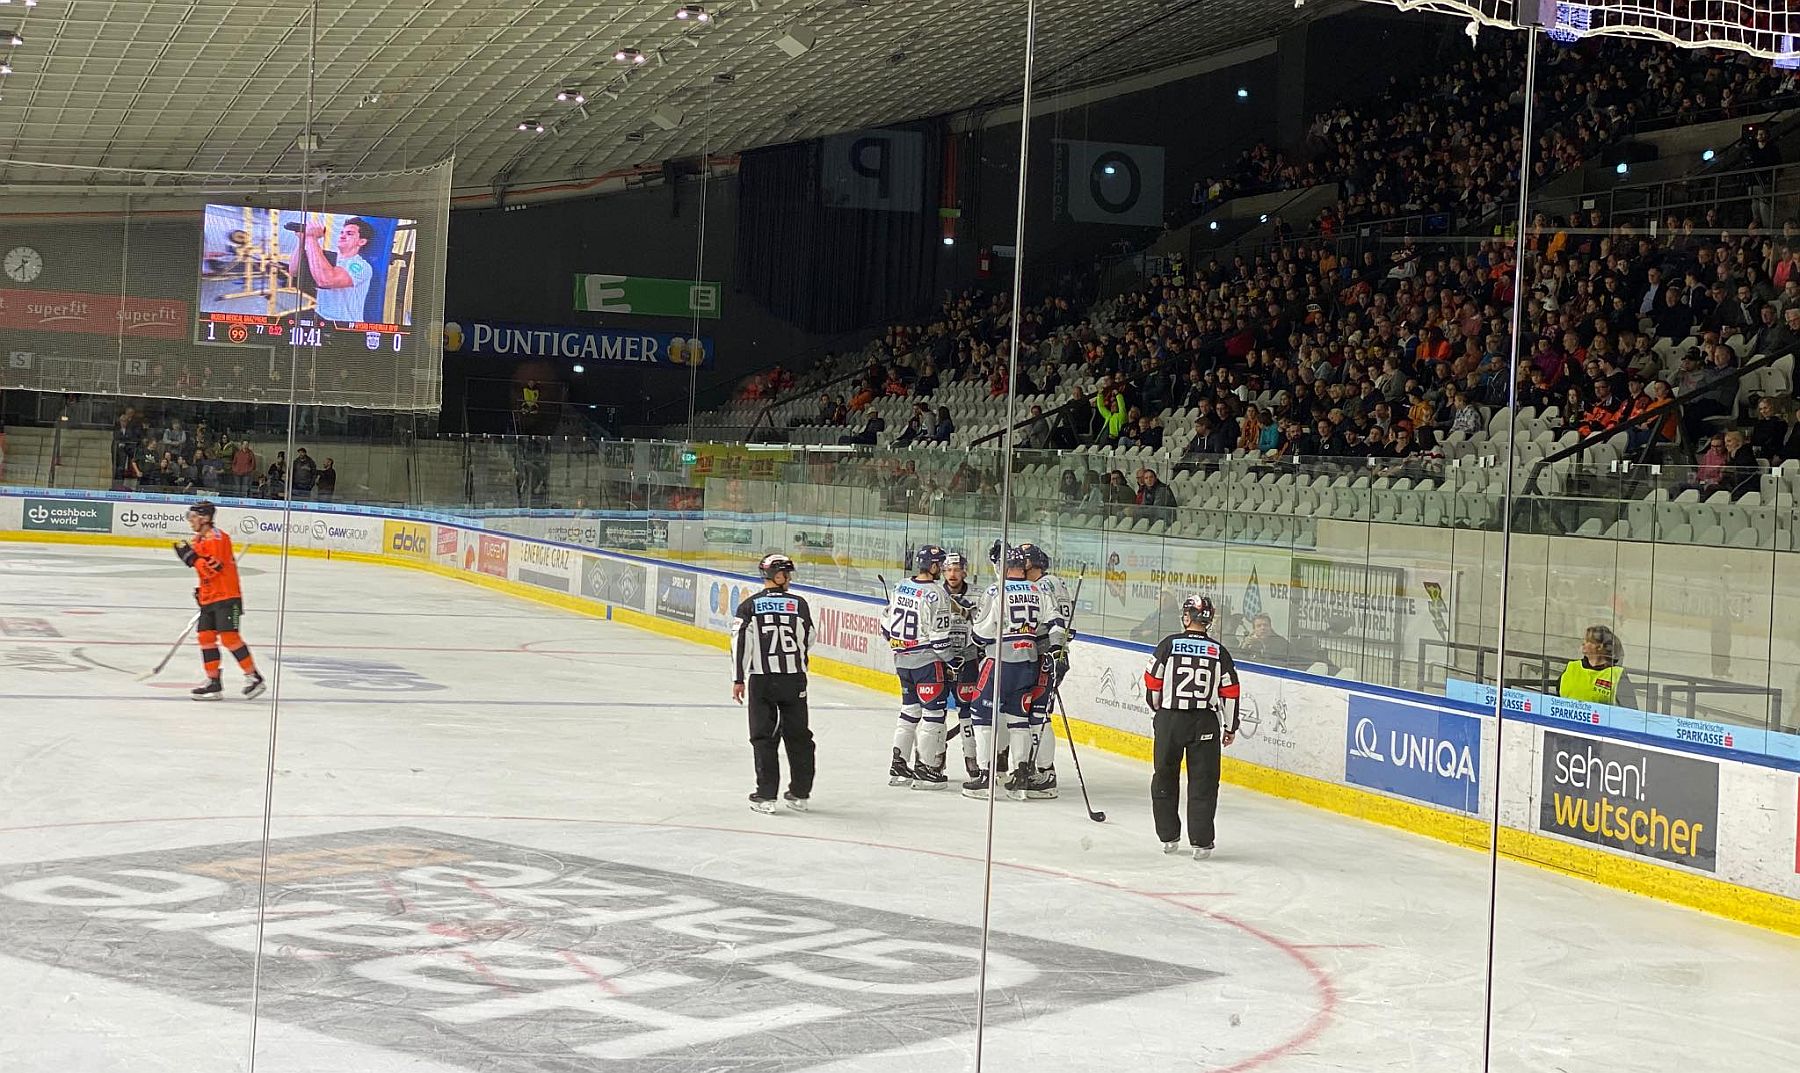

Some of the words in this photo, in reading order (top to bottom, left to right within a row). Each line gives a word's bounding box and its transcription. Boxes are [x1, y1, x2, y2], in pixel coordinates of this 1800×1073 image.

[585, 274, 631, 313] E
[27, 301, 88, 316] superfit
[116, 307, 177, 321] superfit
[207, 321, 215, 340] 1
[232, 330, 245, 339] 99
[289, 327, 322, 346] 10:41
[393, 334, 402, 352] 0
[473, 323, 659, 363] PUNTIGAMER
[17, 354, 26, 366] S
[132, 361, 141, 374] R
[51, 508, 97, 518] cashback
[51, 517, 78, 525] world
[142, 512, 185, 522] cashback
[142, 520, 167, 529] world
[260, 522, 309, 533] GAWROUP
[393, 526, 427, 552] doka
[552, 548, 570, 569] GRAZ
[1151, 570, 1166, 584] DER
[1200, 575, 1217, 590] DEM
[1270, 582, 1289, 599] DER
[757, 602, 785, 611] ERSTE
[1009, 594, 1040, 605] SARAUER
[891, 607, 919, 640] 28
[936, 616, 950, 629] 28
[1010, 605, 1040, 631] 55
[761, 625, 798, 654] 76
[841, 632, 868, 654] MAKLER
[1175, 643, 1206, 654] ERSTE
[1176, 667, 1212, 699] 29
[1485, 695, 1524, 711] SPAKASSE
[1550, 706, 1591, 723] SPARKASSE
[1677, 718, 1724, 733] Steiermärkische
[1263, 736, 1296, 750] PEUGEOT
[1676, 729, 1724, 746] SPARKASSE
[1390, 730, 1476, 783] UNIQA
[1555, 745, 1647, 801] sehen!
[1553, 792, 1704, 858] wutscher
